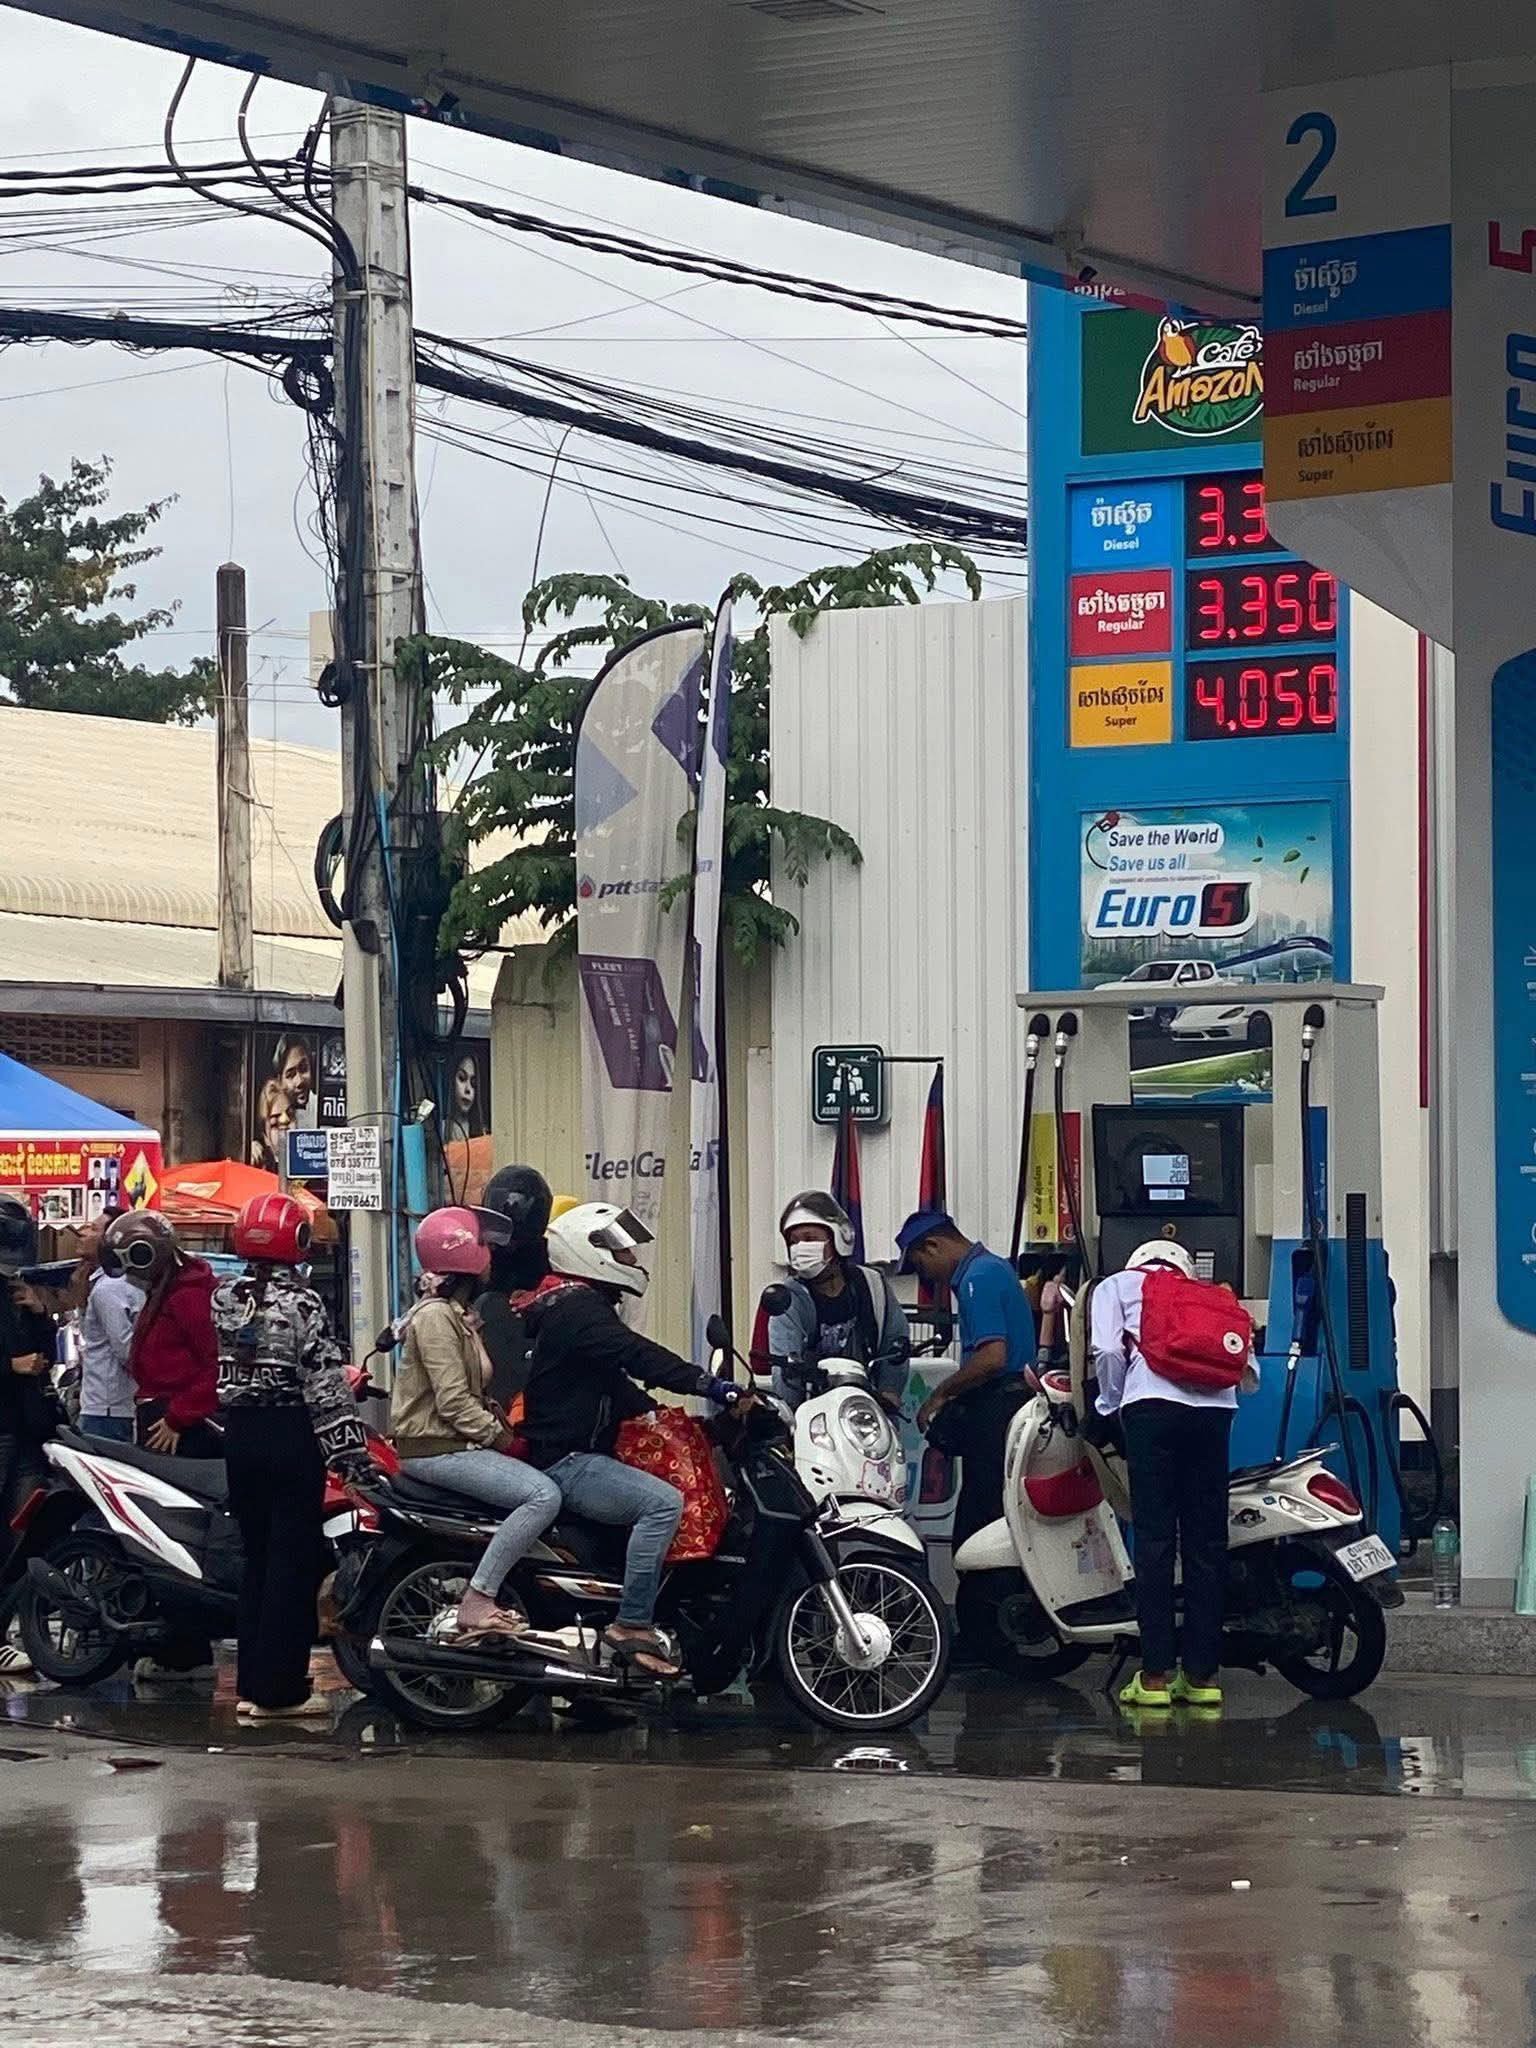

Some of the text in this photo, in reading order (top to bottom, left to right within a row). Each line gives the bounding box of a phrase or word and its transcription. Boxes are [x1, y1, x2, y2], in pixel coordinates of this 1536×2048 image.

[1285, 111, 1338, 218] 2
[1293, 299, 1329, 315] Diesel
[1293, 373, 1341, 392] Regular
[1297, 468, 1334, 485] Super
[1103, 536, 1140, 551] Diesel
[1199, 572, 1337, 640] 3.350
[1097, 618, 1145, 635] Regular
[1196, 665, 1337, 732] 4.050
[1105, 715, 1138, 729] Super
[1108, 828, 1219, 848] Save the World
[1108, 854, 1187, 872] Save us all
[1096, 885, 1240, 928] Euro 5
[856, 1106, 874, 1114] POINT
